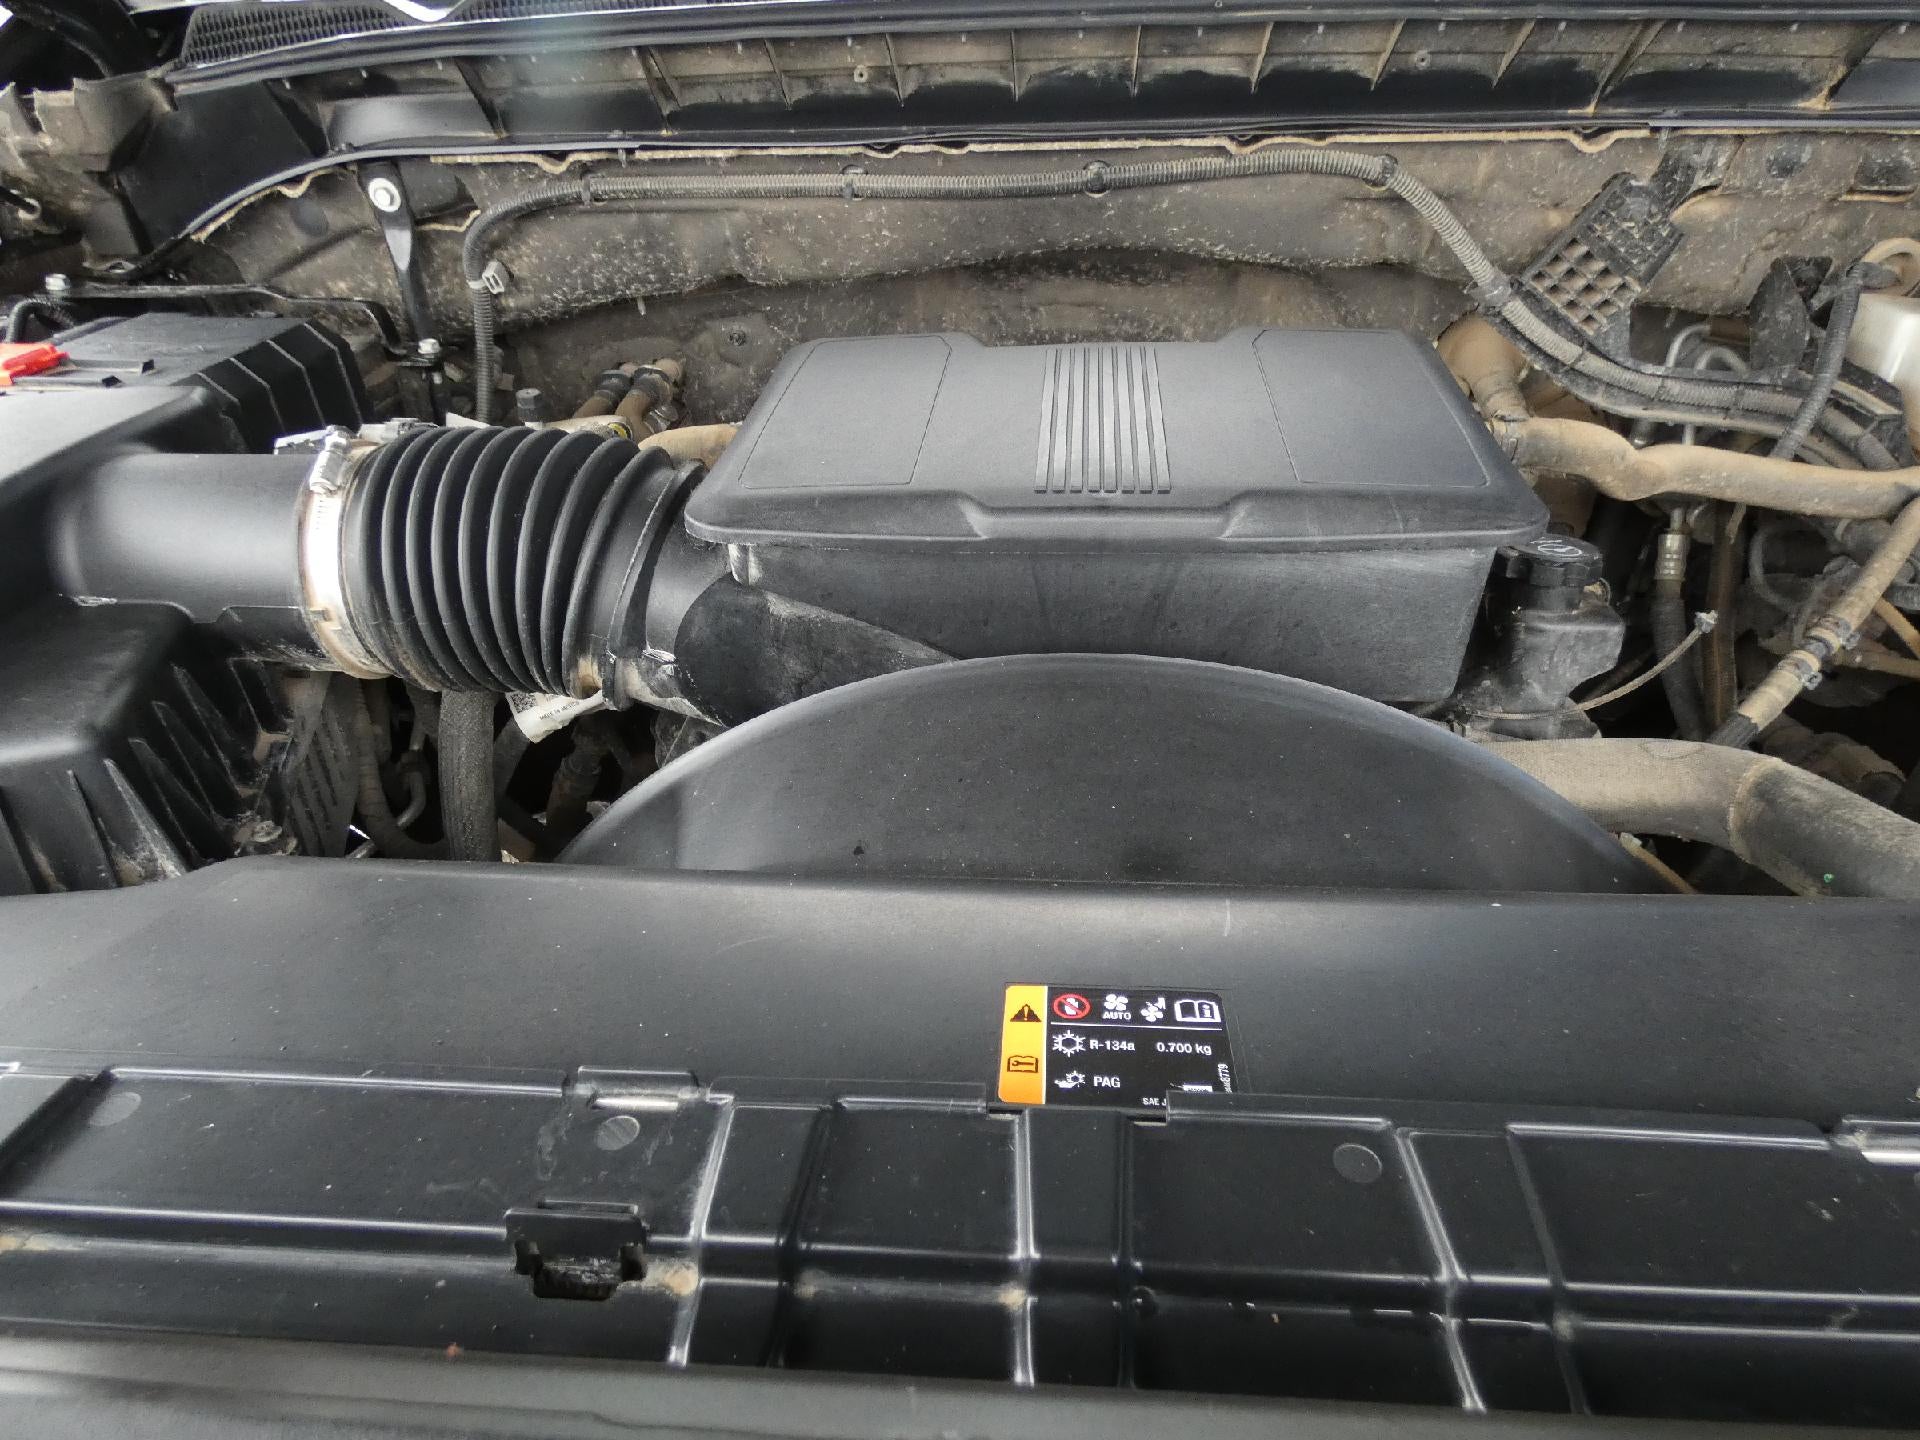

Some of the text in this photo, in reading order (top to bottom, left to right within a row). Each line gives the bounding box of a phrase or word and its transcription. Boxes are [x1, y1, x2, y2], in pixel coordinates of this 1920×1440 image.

[1102, 1011, 1132, 1021] AUTO
[1089, 1038, 1136, 1052] R-134a
[1156, 1041, 1213, 1056] 0.700 kg
[1093, 1075, 1121, 1088] PAG
[1142, 1097, 1160, 1106] SAE
